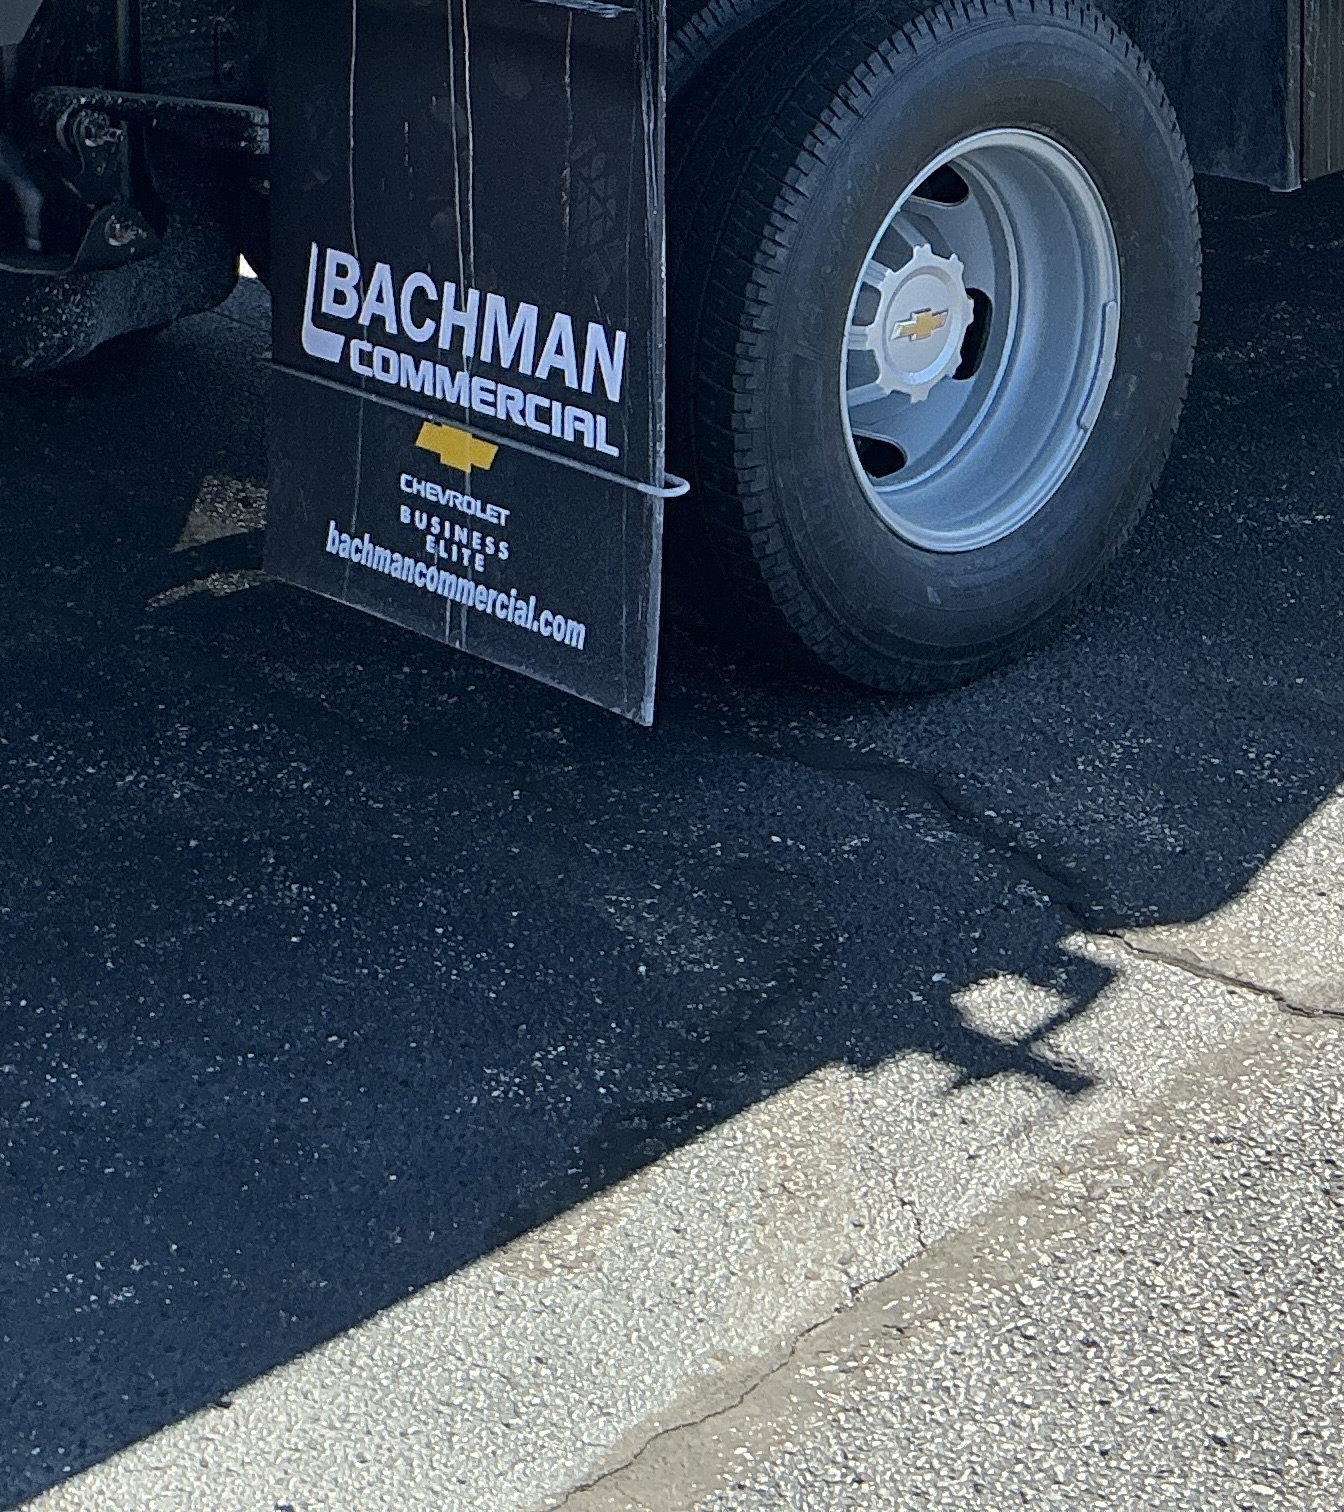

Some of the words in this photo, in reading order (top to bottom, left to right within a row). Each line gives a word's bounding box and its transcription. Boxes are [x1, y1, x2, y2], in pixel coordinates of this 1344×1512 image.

[320, 248, 627, 403] BACHMAN
[350, 338, 620, 457] COMMERCIAL
[399, 473, 511, 527] CHEVROLET
[400, 505, 510, 561] BUSINESS
[326, 520, 587, 651] bachmancommercial.com
[425, 535, 486, 573] ELITE
